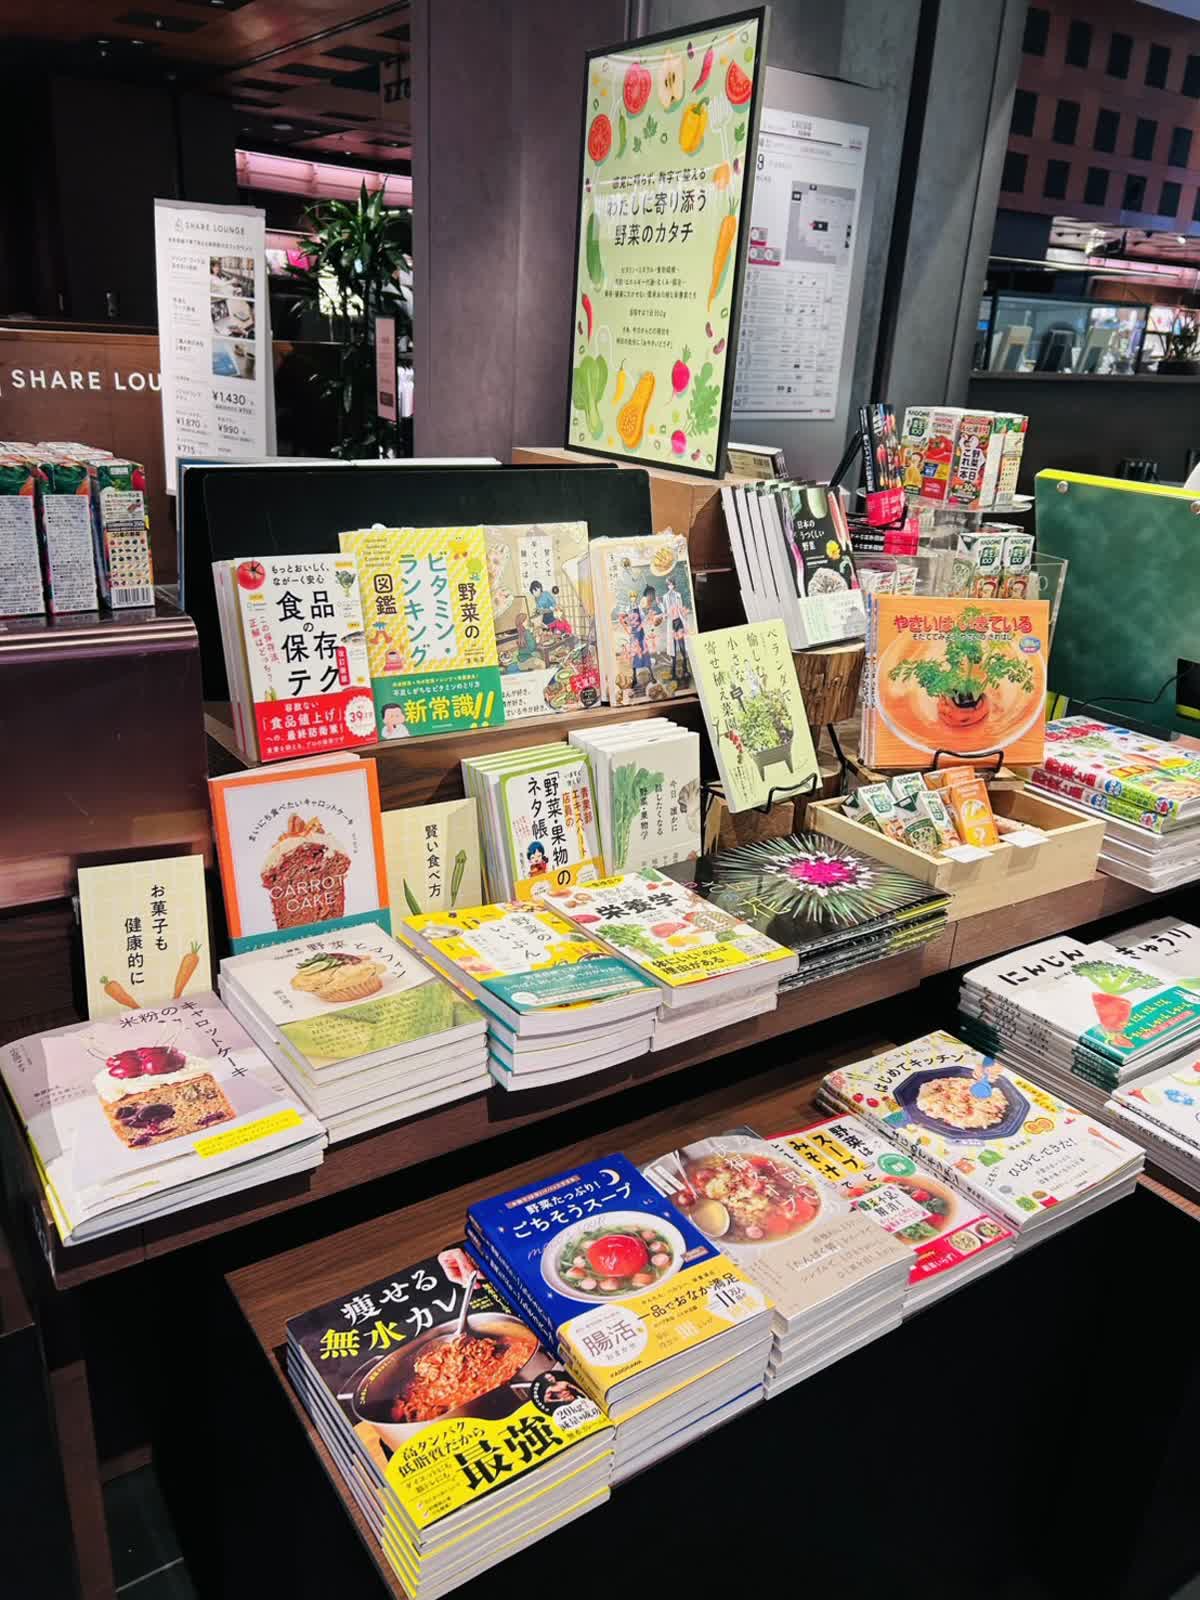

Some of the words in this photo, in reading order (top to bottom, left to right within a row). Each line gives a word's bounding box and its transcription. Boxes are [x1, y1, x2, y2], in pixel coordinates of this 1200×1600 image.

[606, 188, 707, 217] わたしに寄り添う
[614, 221, 694, 247] 野菜のカタチ
[11, 369, 101, 391] SHARE
[796, 519, 816, 530] 日本の
[799, 530, 825, 541] うつくしい
[271, 564, 330, 575] もっとおいしく、
[272, 575, 325, 586] ながーく安心
[276, 590, 335, 622] 食品
[374, 573, 398, 616] 図鑑
[400, 553, 432, 668] ランキング
[458, 582, 481, 639] 野菜の
[303, 622, 314, 633] の
[281, 631, 339, 663] 保存
[727, 636, 745, 683] 小さな
[768, 629, 792, 702] ベランダで
[288, 666, 340, 696] テク
[527, 776, 549, 840] ネタ帳
[424, 823, 442, 898] 賢い食べ方
[269, 874, 348, 900] CARROT
[286, 892, 342, 912] CAKE
[150, 883, 169, 951] お菓子も
[595, 892, 679, 921] 栄養学
[124, 916, 145, 985] 健康的に
[1115, 927, 1193, 960] きゅうり
[998, 948, 1087, 986] にんじん
[119, 1000, 249, 1079] 米粉のキャロットケーキ
[873, 1052, 966, 1094] はじめてキッチン
[828, 1123, 876, 1158] 野菜は
[511, 1182, 633, 1239] ごちそうスープ
[525, 1180, 602, 1216] 野菜たっぷり!
[340, 1269, 439, 1326] 痩せる
[397, 1426, 487, 1478] 低脂質だから
[400, 1419, 467, 1463] 高タンパク
[454, 1414, 565, 1491] 最強
